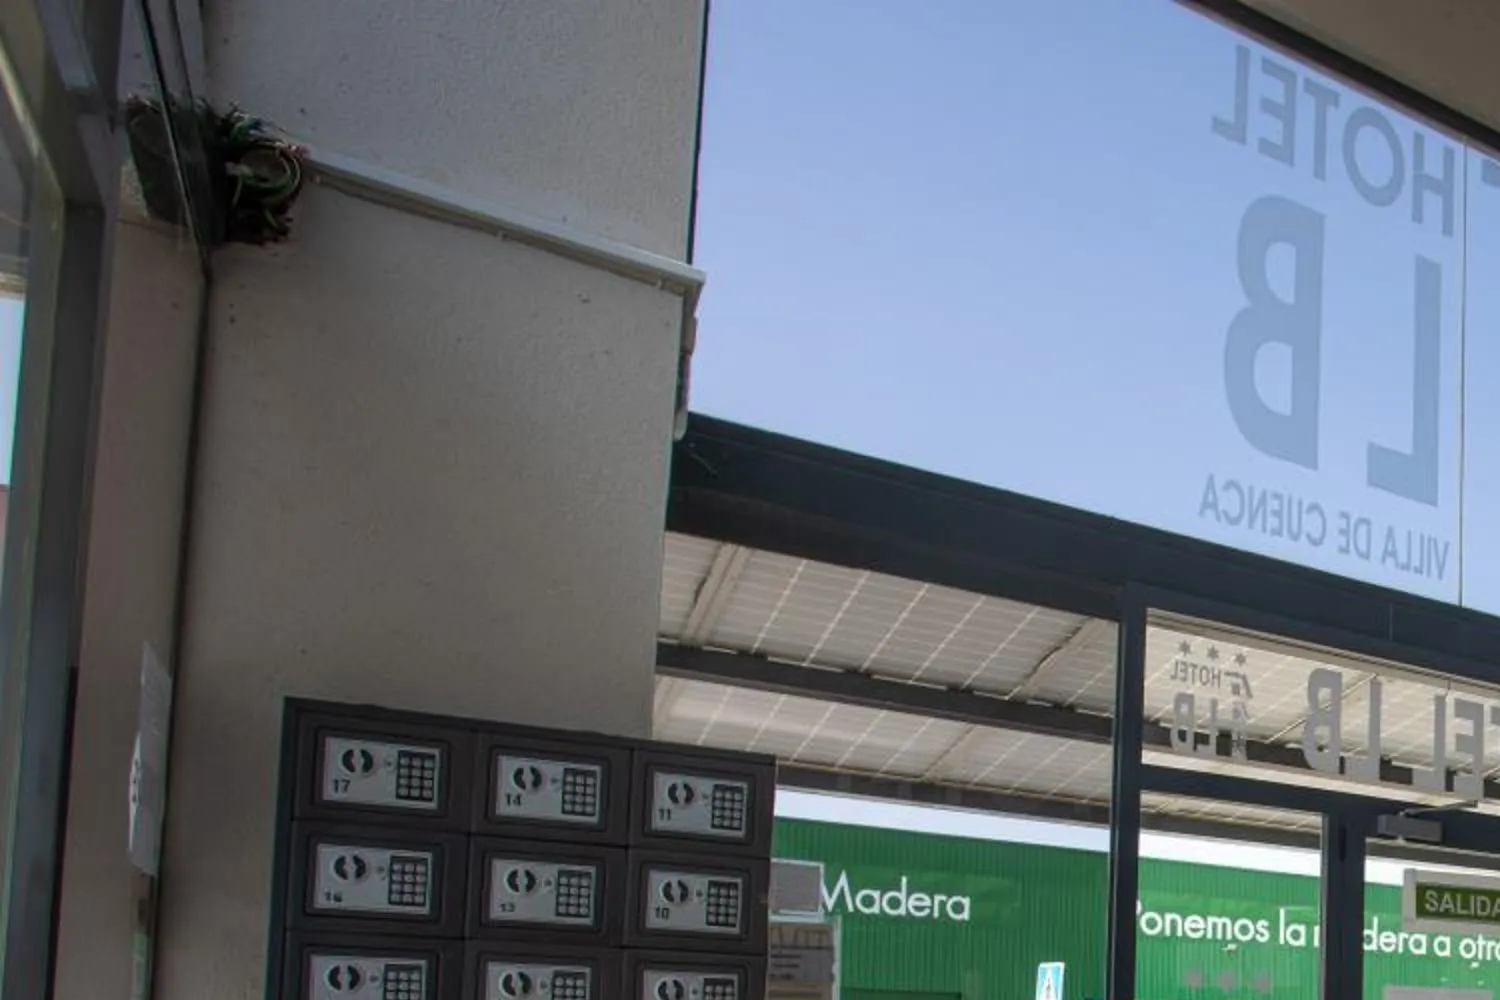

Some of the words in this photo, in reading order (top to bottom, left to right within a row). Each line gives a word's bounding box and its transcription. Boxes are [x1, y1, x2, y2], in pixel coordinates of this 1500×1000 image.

[333, 779, 351, 793] 17
[505, 792, 522, 807] 14
[658, 808, 672, 821] 11
[821, 869, 971, 922] Madera
[1135, 899, 1270, 943] onemos
[1279, 907, 1306, 947] la
[1433, 934, 1452, 958] a
